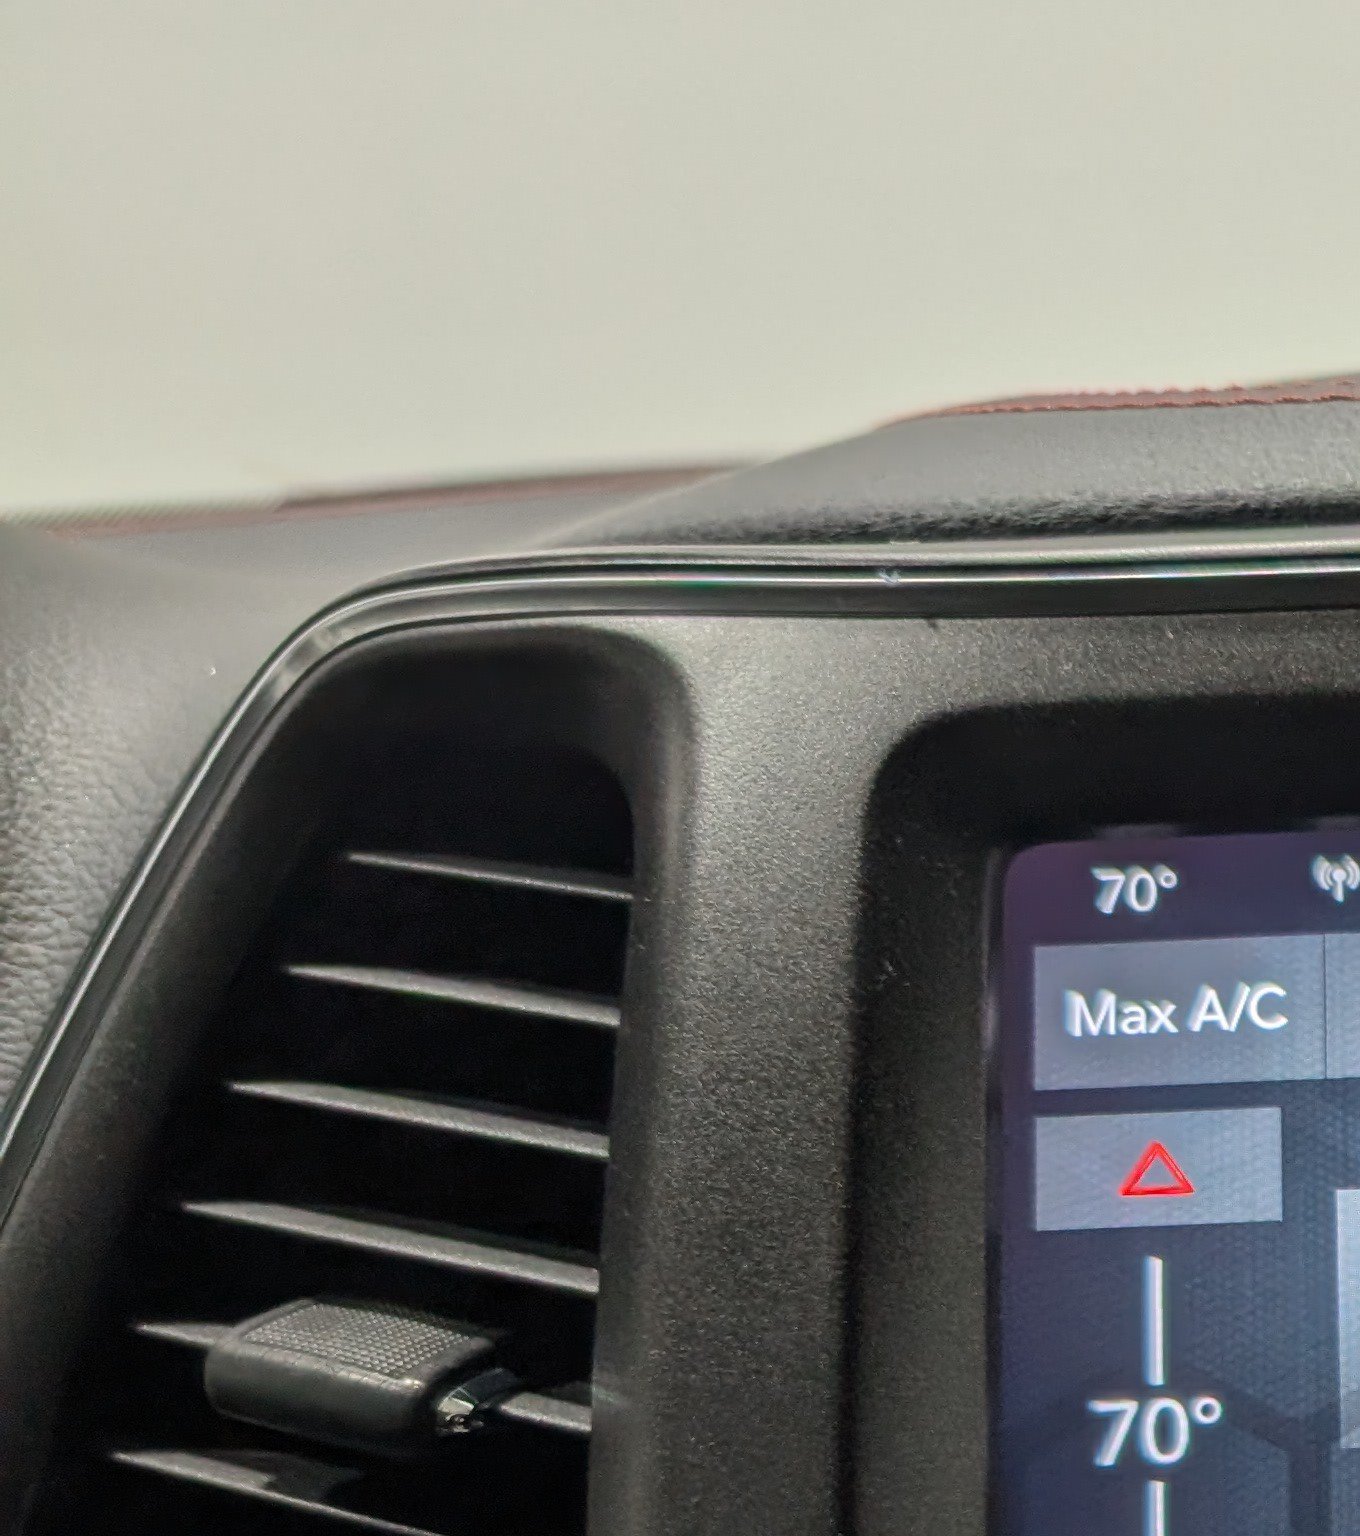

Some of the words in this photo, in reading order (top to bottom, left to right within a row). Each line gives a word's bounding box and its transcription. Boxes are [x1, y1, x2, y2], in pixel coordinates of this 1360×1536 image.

[1092, 866, 1178, 915] 70°
[1066, 989, 1178, 1037] Max
[1191, 981, 1289, 1032] A/C
[1088, 1397, 1221, 1467] 70°
